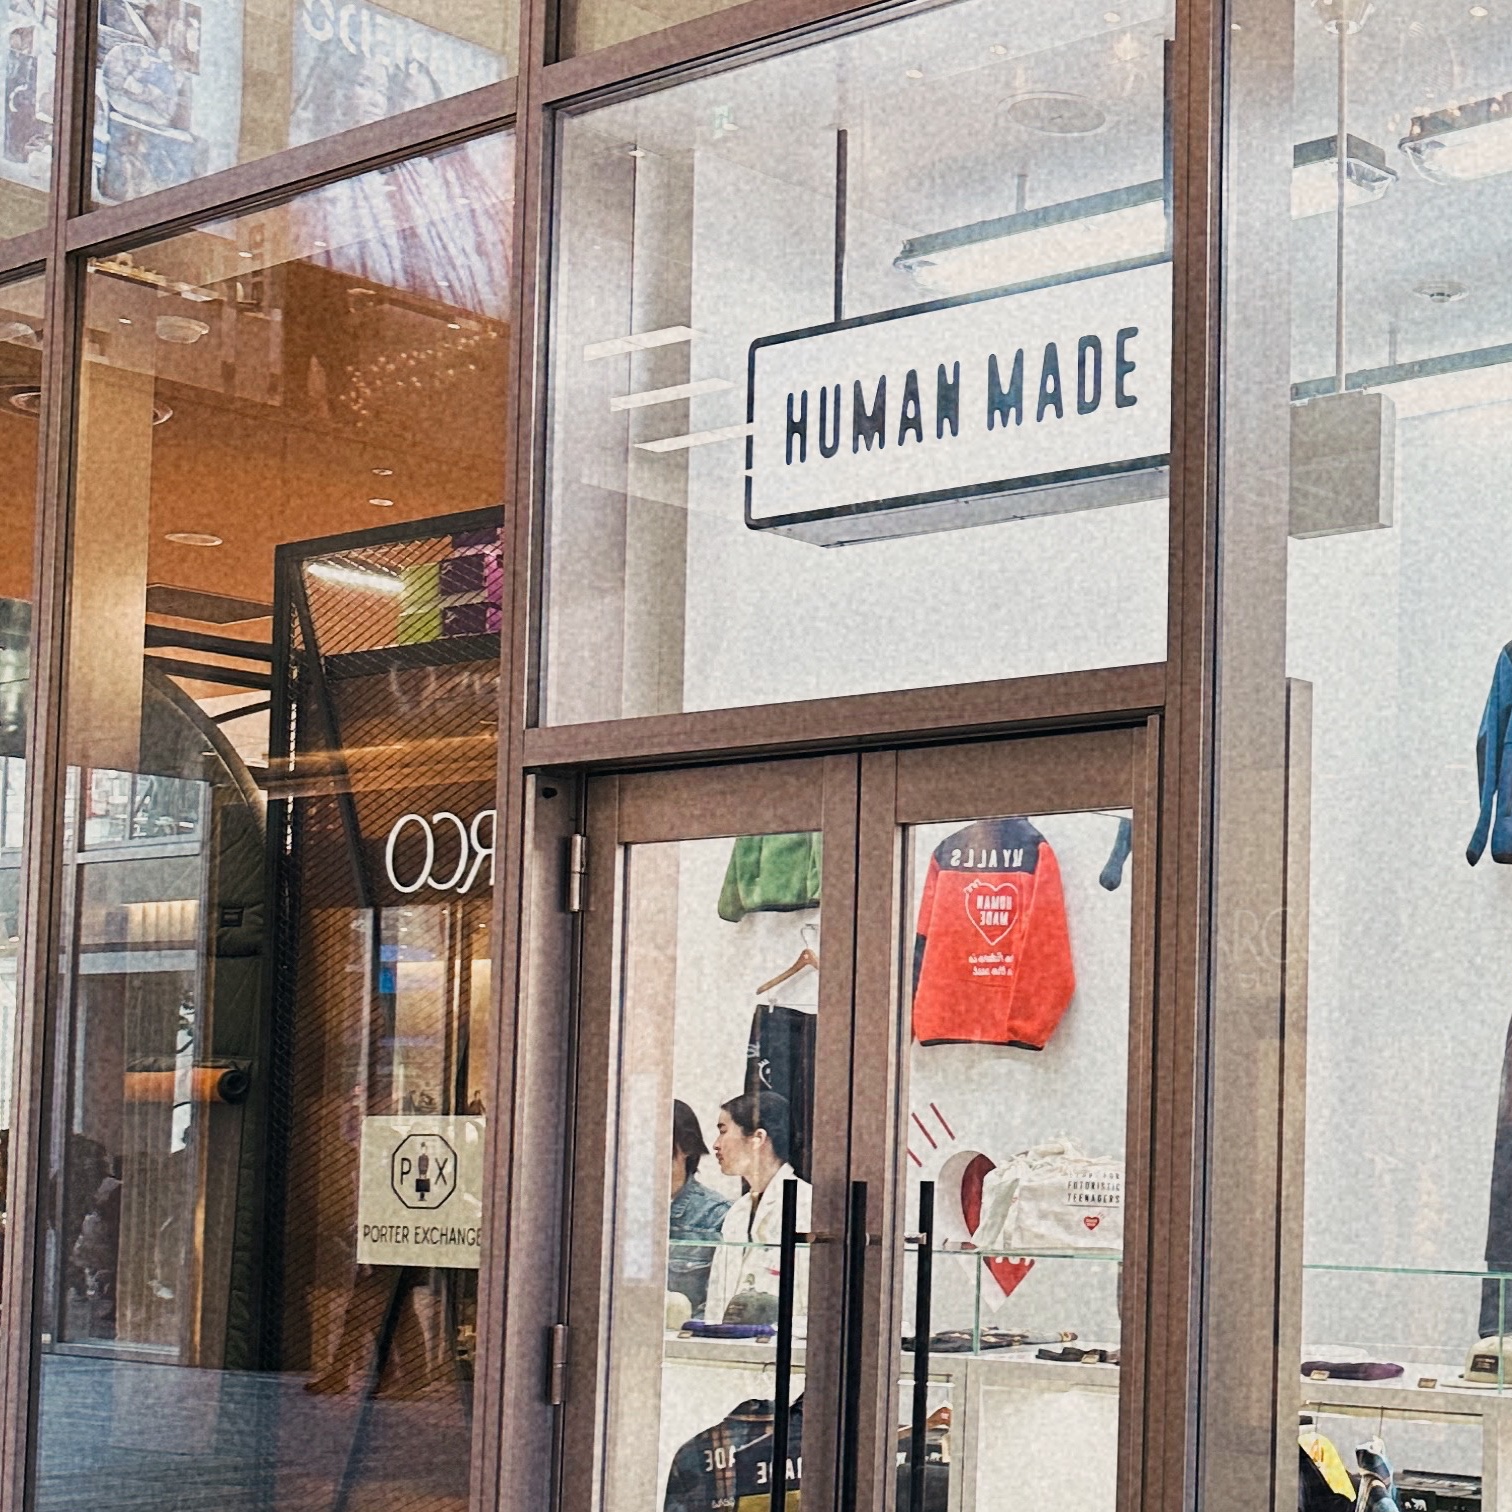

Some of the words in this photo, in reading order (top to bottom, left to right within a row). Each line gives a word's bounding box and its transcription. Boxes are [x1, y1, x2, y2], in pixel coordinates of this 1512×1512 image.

[785, 359, 961, 466] HUMAN
[986, 326, 1140, 432] MADE
[400, 1157, 412, 1186] P
[434, 1157, 449, 1186] X
[363, 1224, 410, 1245] PORTER
